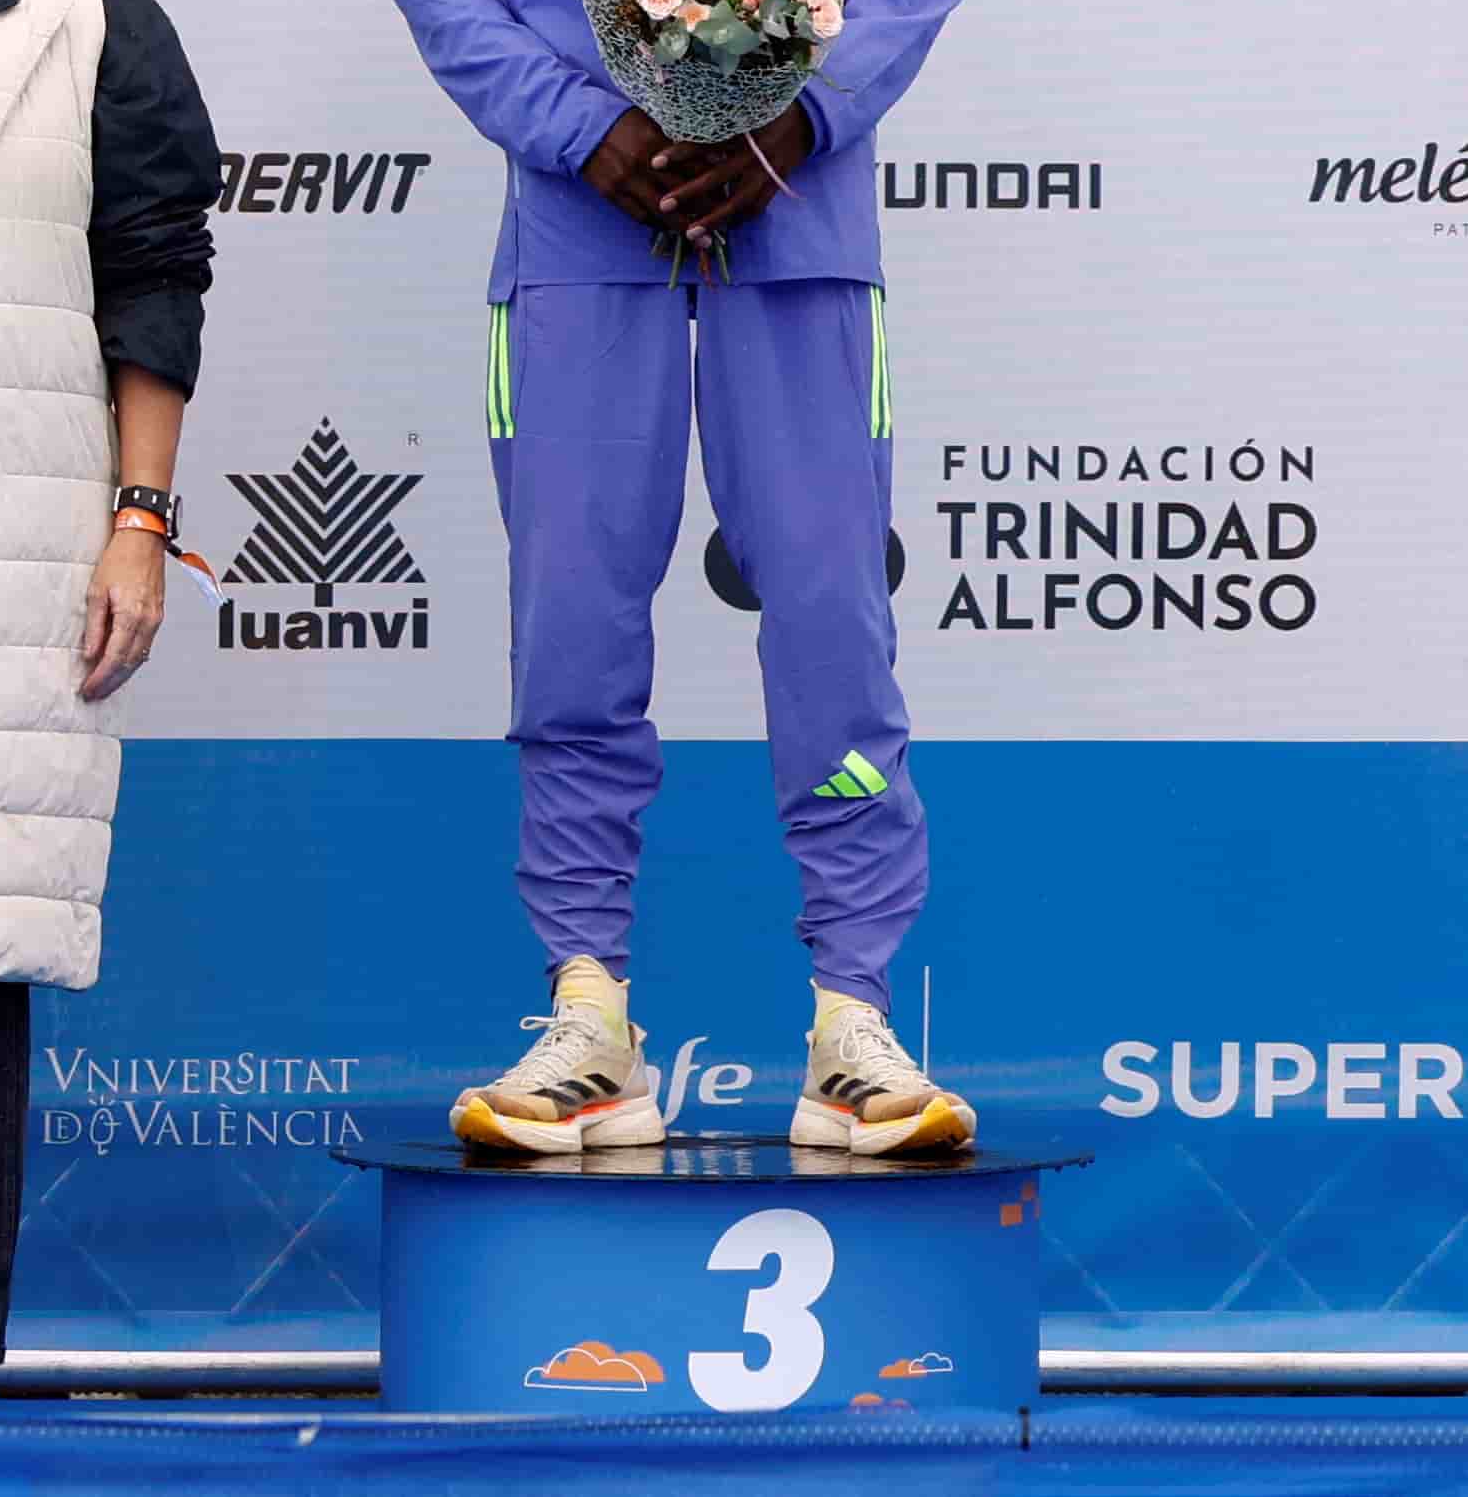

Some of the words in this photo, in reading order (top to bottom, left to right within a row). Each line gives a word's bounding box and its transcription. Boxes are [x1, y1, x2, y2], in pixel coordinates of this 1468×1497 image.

[875, 162, 1102, 210] UNDAI
[944, 439, 1312, 481] FUNDACIÓN
[937, 502, 1316, 560] TRINIDAD
[218, 597, 429, 650] luanvi
[939, 574, 1315, 630] ALFONSO
[1099, 1040, 1467, 1119] SUPER
[123, 1100, 364, 1146] VALÈNCIA
[688, 1207, 835, 1412] 3
